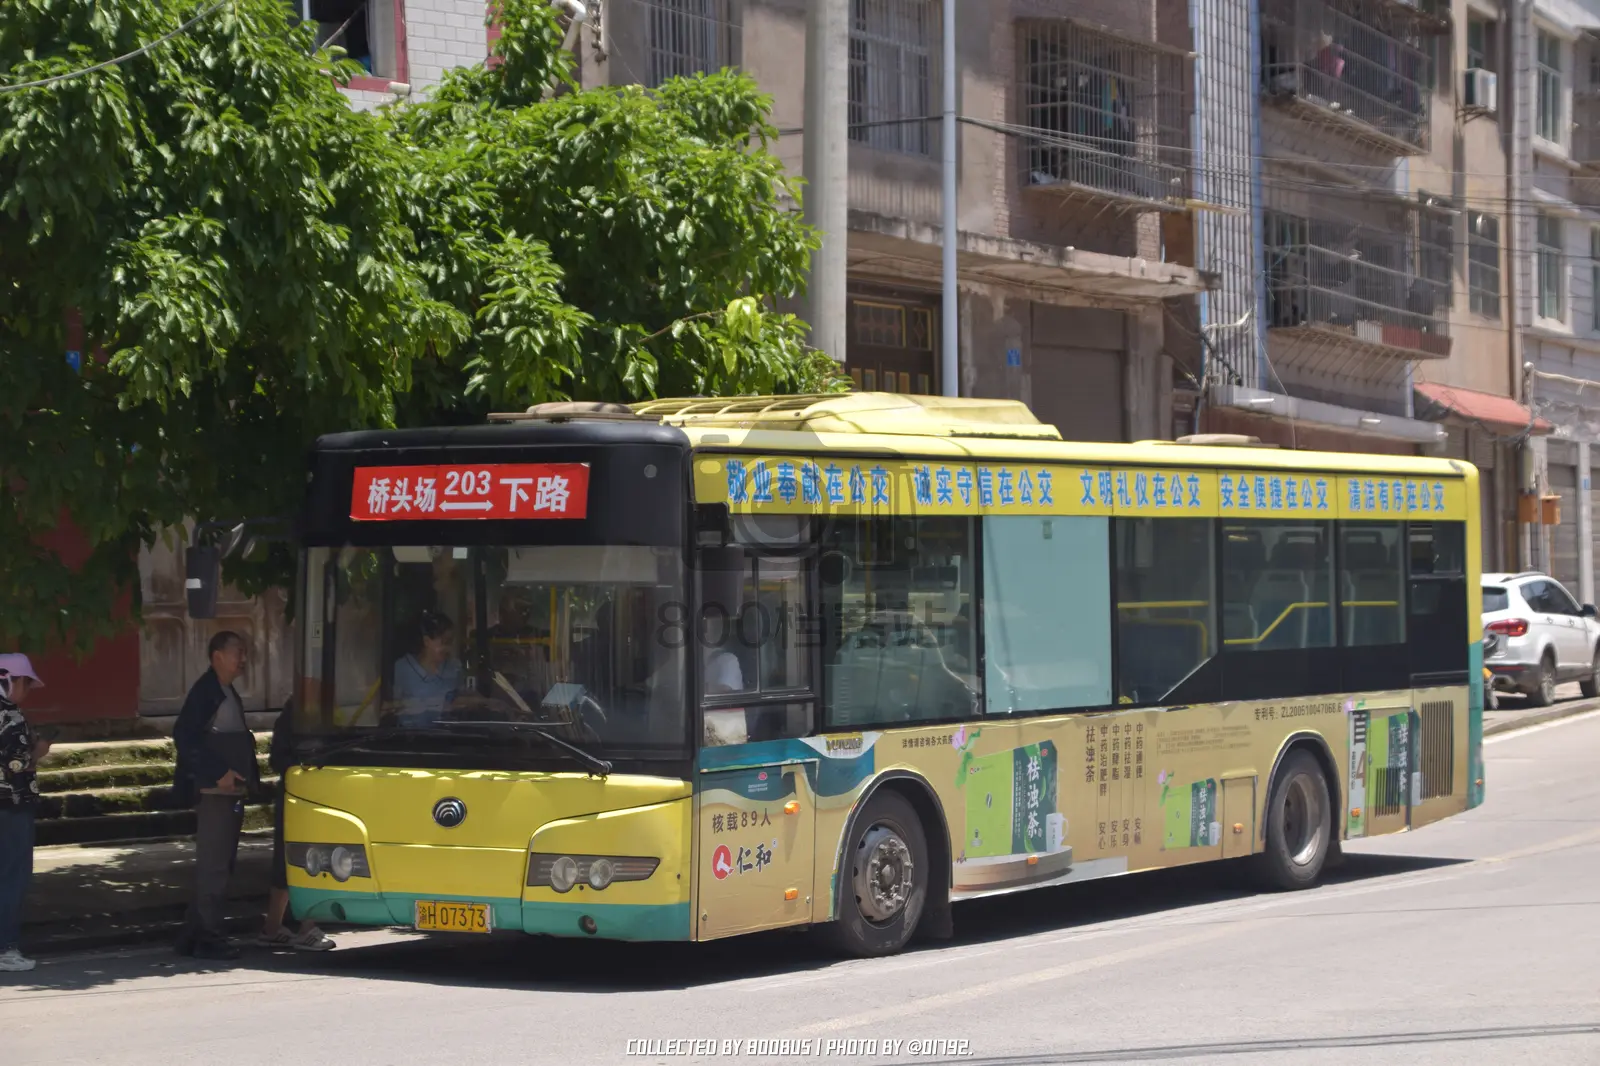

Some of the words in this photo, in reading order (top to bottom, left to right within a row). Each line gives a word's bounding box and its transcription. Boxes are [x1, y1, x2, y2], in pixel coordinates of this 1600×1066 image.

[367, 477, 436, 513] 桥头场
[444, 471, 491, 495] 203
[500, 475, 571, 512] 下路
[726, 459, 890, 504] 敬业奉献在公交
[914, 465, 1055, 506] 诚实守信在公交
[1080, 469, 1201, 508] 文明礼仪在公交
[1220, 474, 1329, 510] 安全便捷在公交
[1348, 479, 1445, 512] 清洁有序在公交
[1086, 725, 1095, 783] 祛浊茶
[712, 808, 771, 834] 核载89人
[1027, 756, 1041, 839] 祛浊茶
[736, 843, 772, 874] 仁和
